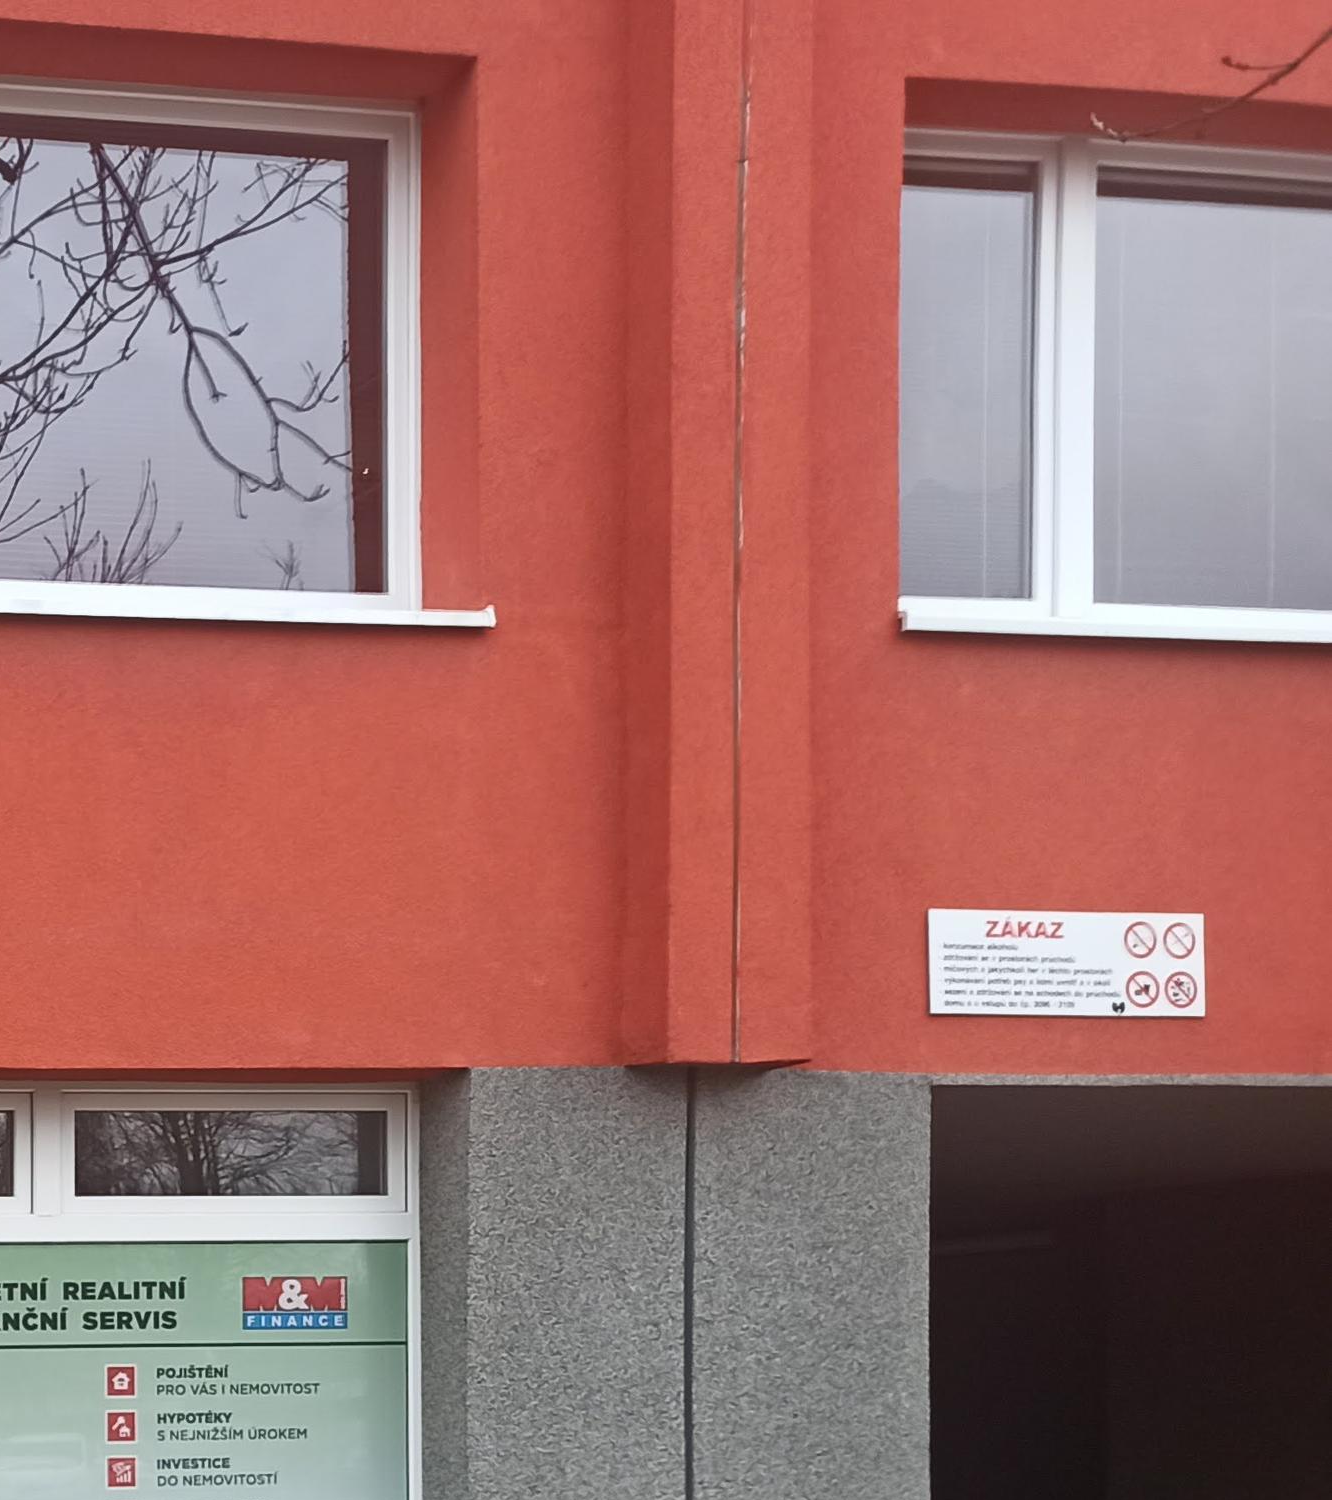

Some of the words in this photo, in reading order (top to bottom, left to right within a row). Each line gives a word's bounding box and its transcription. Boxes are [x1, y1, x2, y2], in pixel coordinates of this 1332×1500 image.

[985, 916, 1065, 938] ZÁKAZ
[63, 1276, 186, 1300] REALITNÍ
[243, 1277, 347, 1311] M&M
[82, 1310, 178, 1331] SERVIS
[247, 1315, 344, 1327] FINANCE
[156, 1365, 229, 1380] POJIŠTĚNÍ
[156, 1383, 187, 1396] PRO
[190, 1381, 218, 1395] VÁS
[221, 1383, 226, 1395] I
[229, 1382, 320, 1395] NEMOVITOST
[157, 1410, 232, 1425] HYPOTÉKY
[157, 1429, 166, 1442] S
[169, 1426, 244, 1442] NEJNIŽŠÍM
[247, 1425, 308, 1441] ÚROKEM
[157, 1457, 231, 1471] INVESTICE
[157, 1473, 179, 1487] DO
[182, 1471, 278, 1487] NEMOVITOSTÍ
